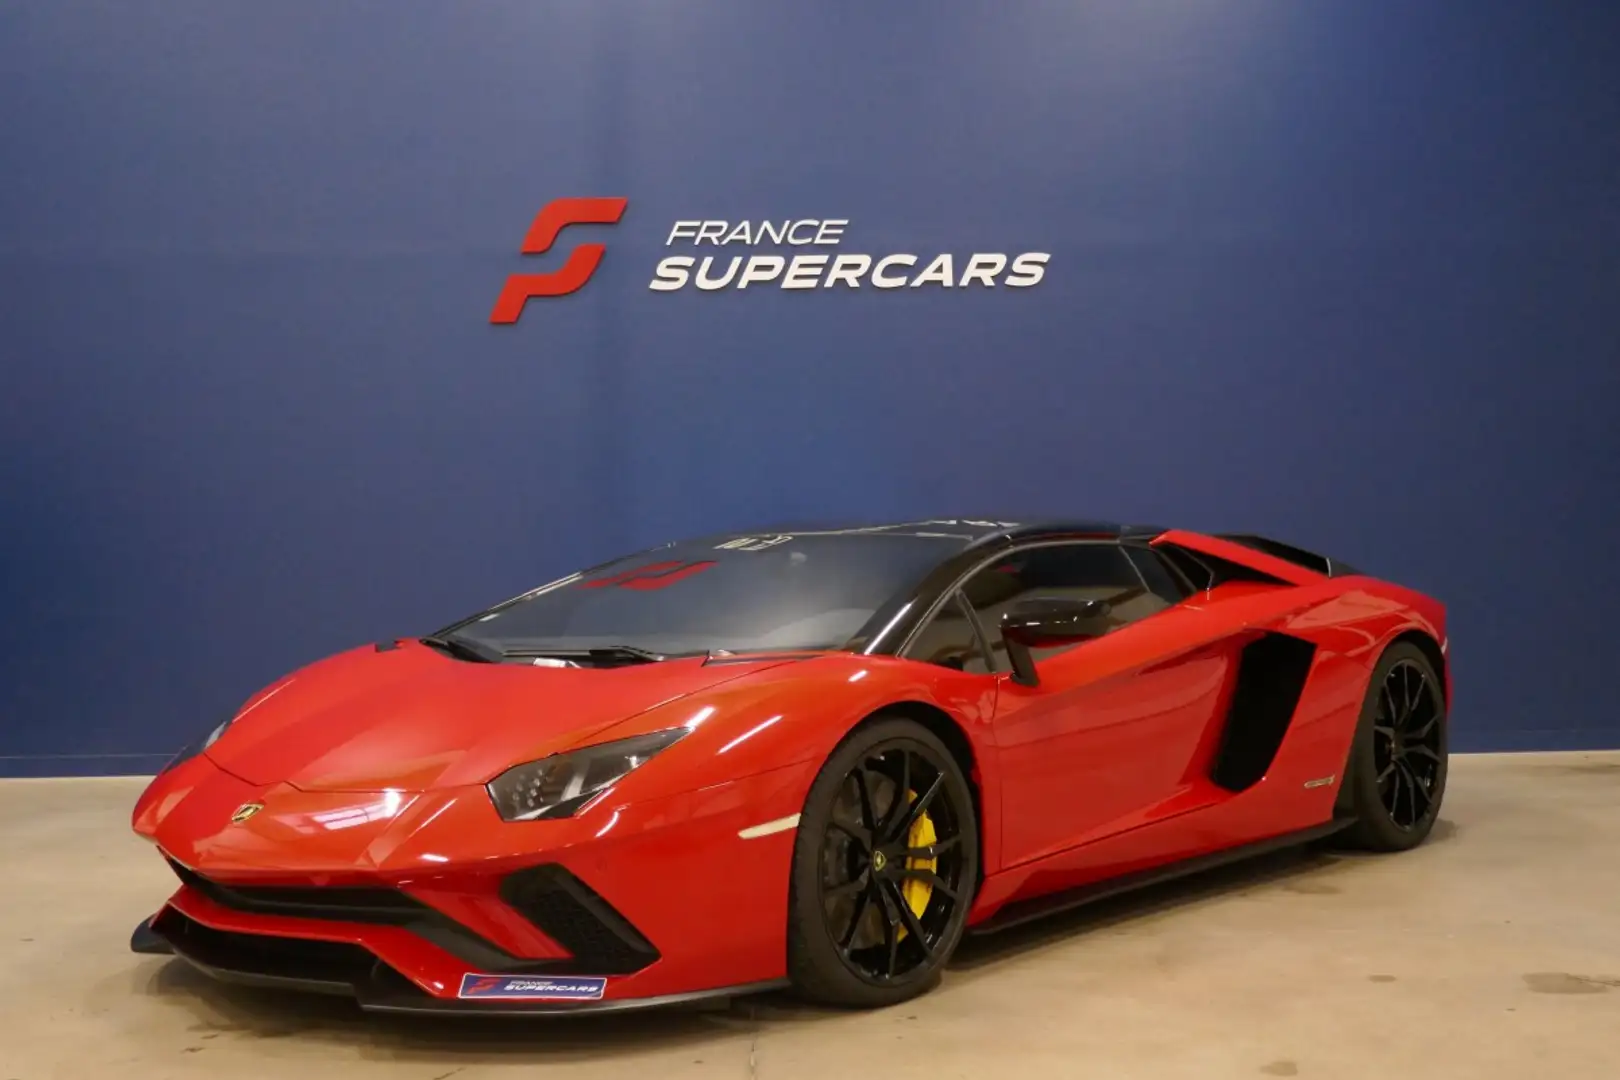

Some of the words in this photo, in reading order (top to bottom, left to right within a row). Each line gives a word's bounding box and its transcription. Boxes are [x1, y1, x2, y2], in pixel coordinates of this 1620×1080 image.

[665, 218, 849, 246] FRANCE
[648, 252, 1051, 291] SUPERCARS
[503, 984, 598, 993] SUPERCARS
